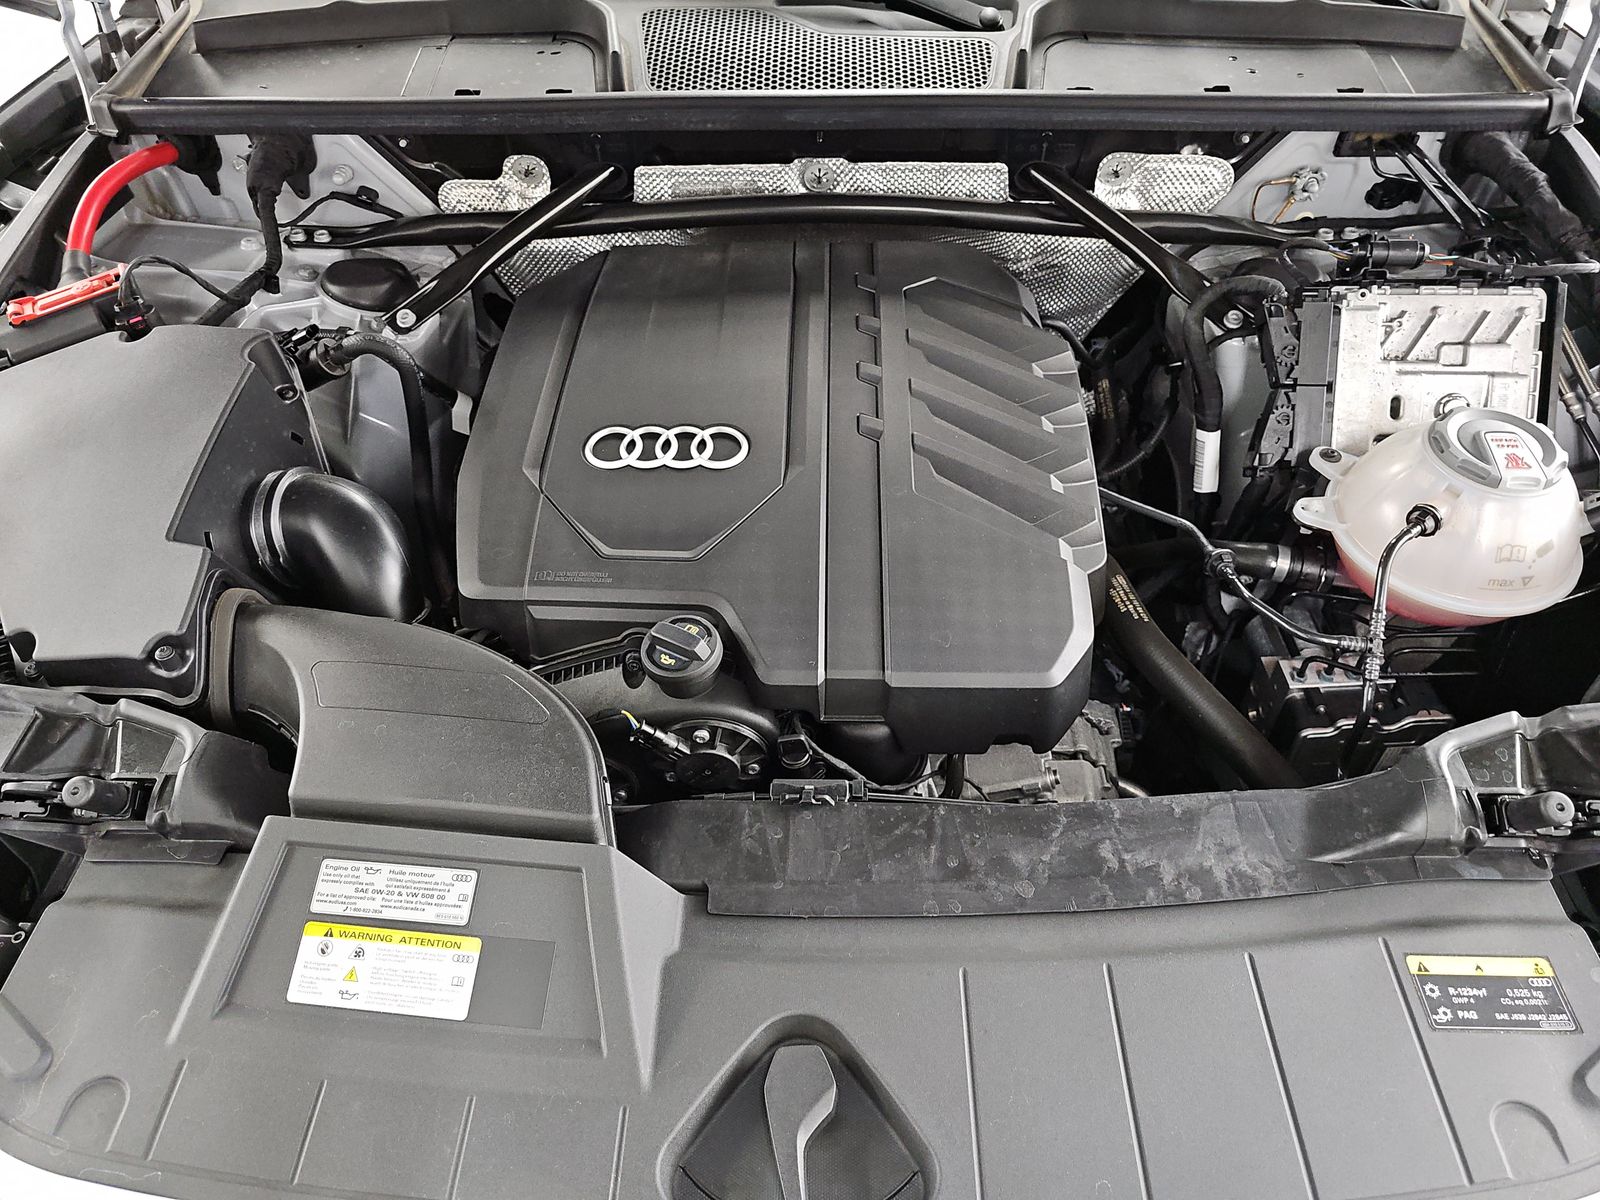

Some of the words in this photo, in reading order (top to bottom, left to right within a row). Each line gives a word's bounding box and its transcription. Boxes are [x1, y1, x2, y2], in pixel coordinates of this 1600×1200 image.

[1488, 577, 1515, 587] max
[325, 864, 349, 872] Engine
[371, 889, 396, 897] 0W-20
[338, 929, 394, 943] WARNING
[398, 936, 462, 950] ATTENTION
[1448, 987, 1488, 998] R-1234yf
[1532, 989, 1544, 999] kg
[1457, 1010, 1479, 1020] PAG
